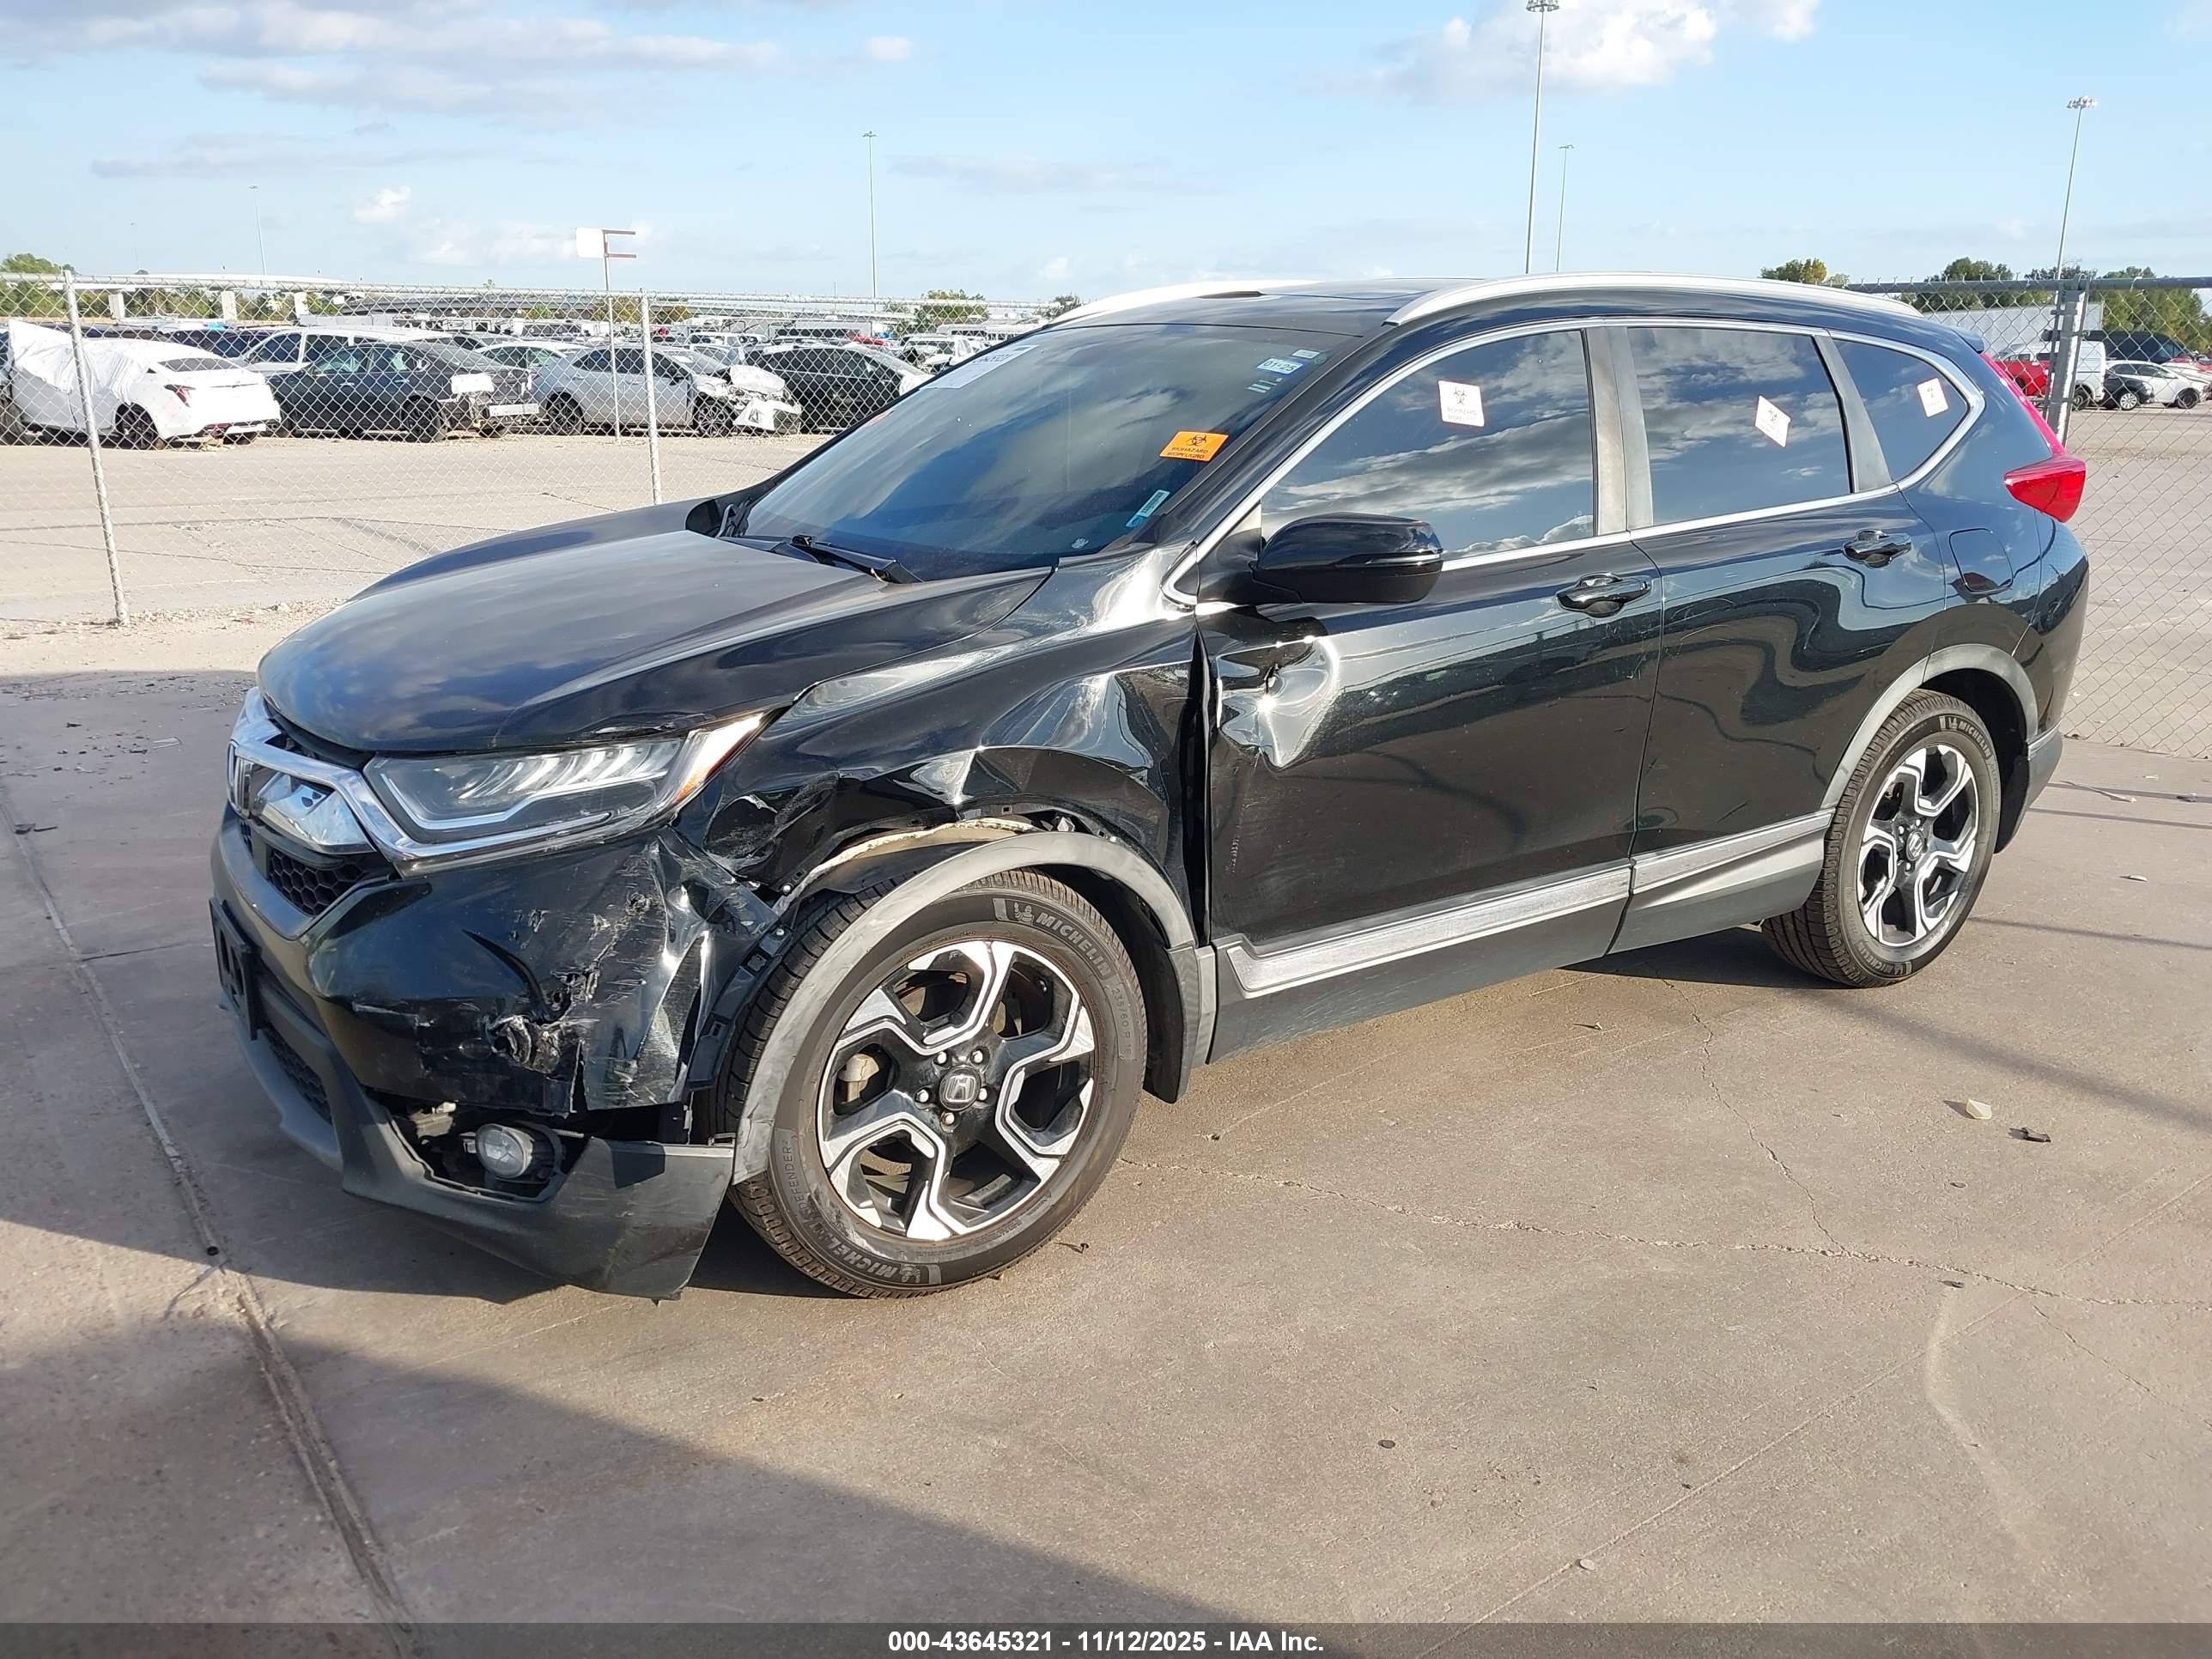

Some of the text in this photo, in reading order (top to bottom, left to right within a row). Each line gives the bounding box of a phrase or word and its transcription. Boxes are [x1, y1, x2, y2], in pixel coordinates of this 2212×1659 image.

[1958, 720, 1991, 757] MICHELIN
[1036, 911, 1112, 977] MICHELIN
[809, 1221, 898, 1279] MICHELIN
